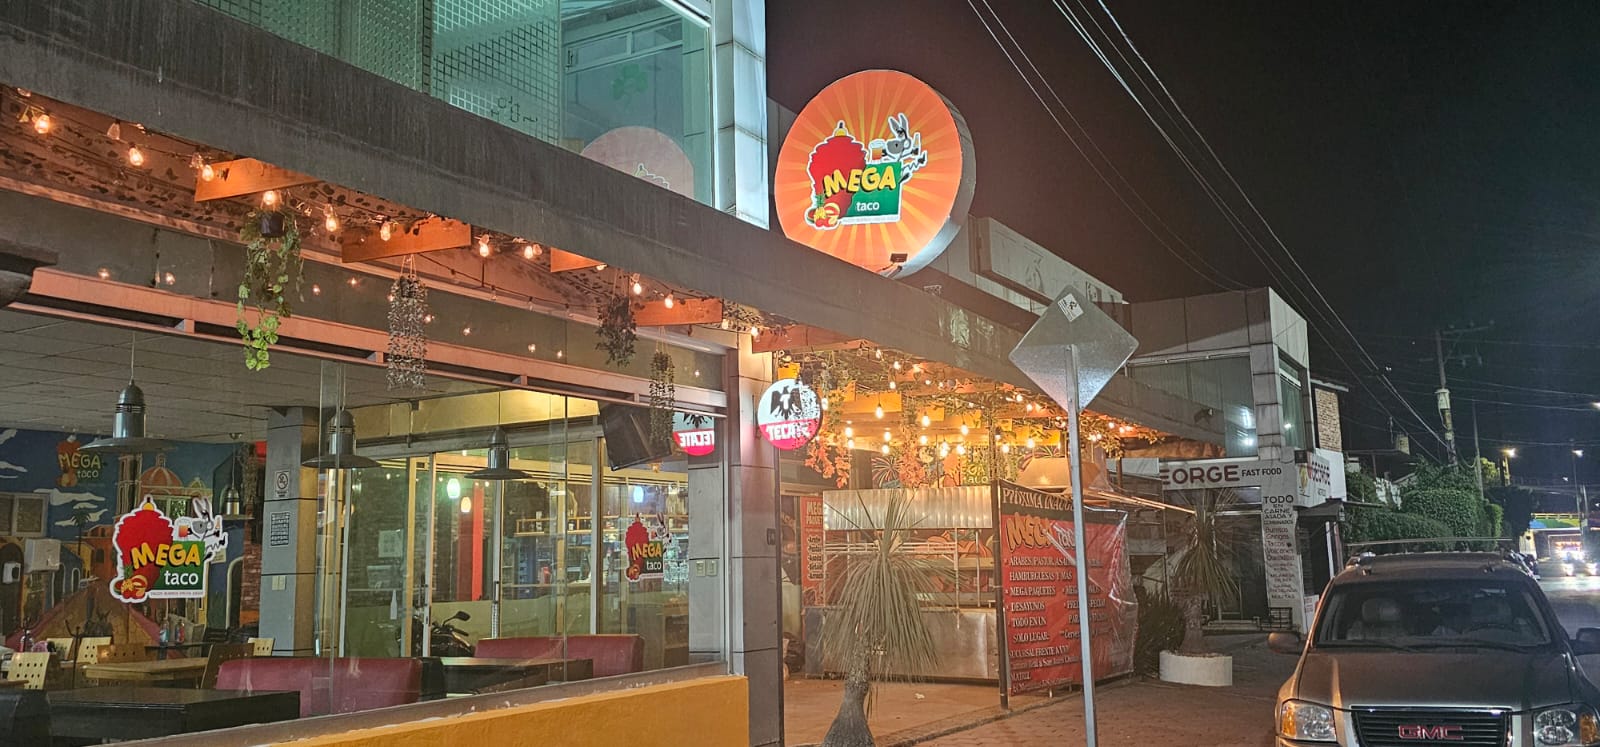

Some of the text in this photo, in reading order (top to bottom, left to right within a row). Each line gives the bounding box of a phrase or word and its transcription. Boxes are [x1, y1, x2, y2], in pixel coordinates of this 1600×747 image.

[823, 165, 896, 198] MEGA
[856, 200, 880, 212] taco
[58, 452, 101, 470] MEGA
[77, 469, 99, 479] taco
[1159, 464, 1282, 486] EORGE FAST FOOD
[1263, 494, 1294, 504] TODO
[806, 501, 823, 515] MEG
[1006, 512, 1053, 552] MEGA
[131, 542, 201, 570] MEGA
[631, 543, 662, 560] MEGA
[647, 559, 662, 570] taco
[164, 570, 199, 585] taco
[1009, 571, 1055, 581] HAMBURGUESAS
[1010, 586, 1056, 596] MEGA PAQUETES
[1011, 602, 1045, 611] DESAYUNOS
[1012, 618, 1029, 627] TODO
[1013, 633, 1029, 642] SOLO
[1398, 725, 1464, 740] GMC
